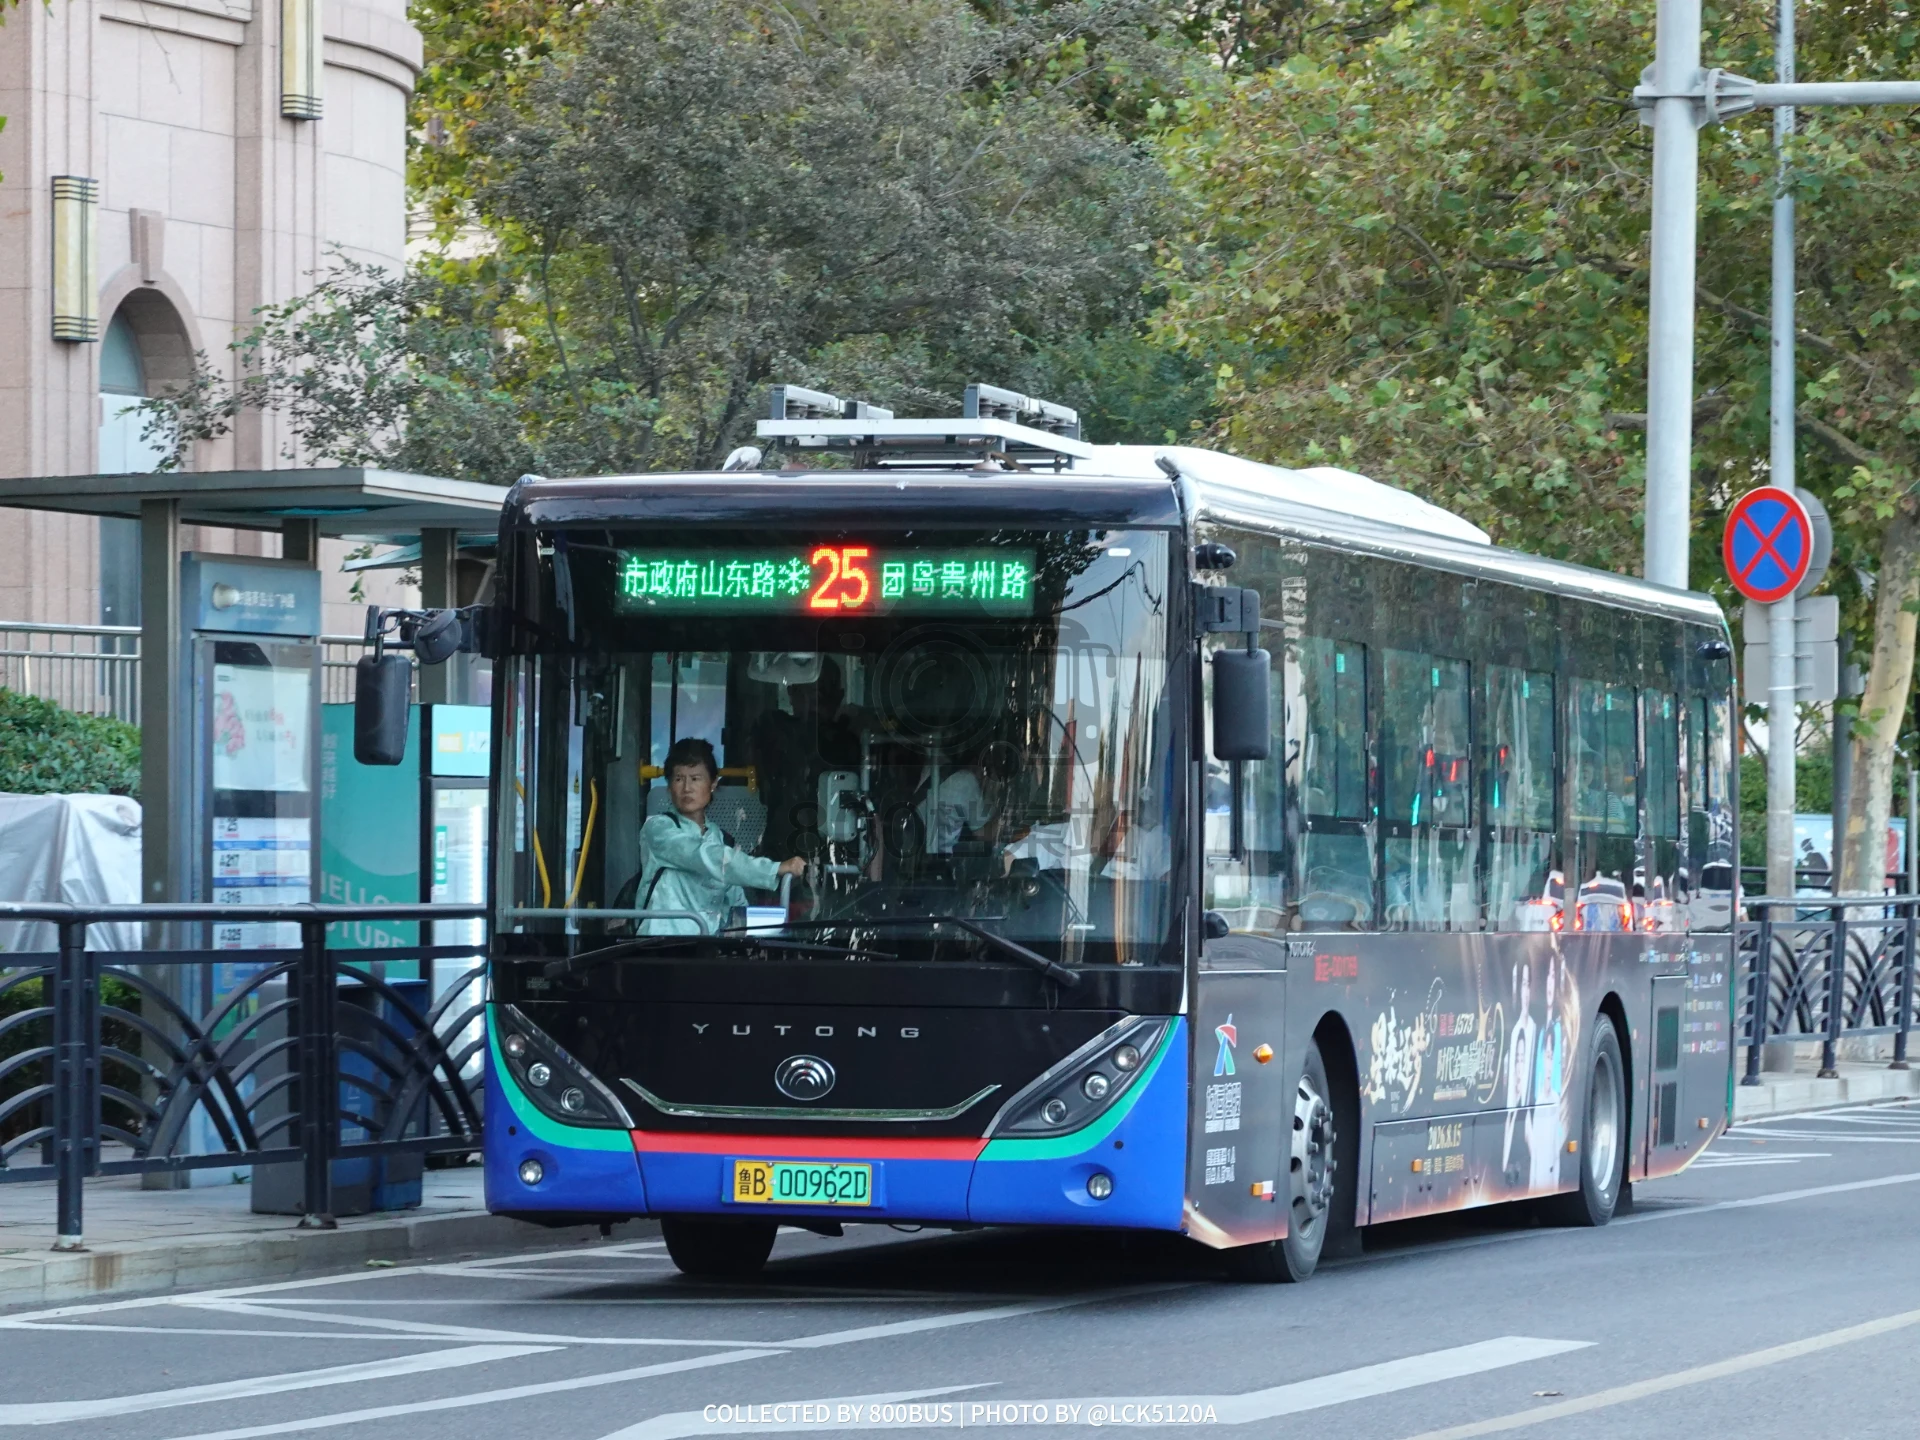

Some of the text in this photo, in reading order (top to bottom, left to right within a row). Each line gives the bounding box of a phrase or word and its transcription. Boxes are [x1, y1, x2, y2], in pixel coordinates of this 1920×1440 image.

[624, 548, 1028, 608] 市政府山东路 25 团岛贵州路
[692, 1022, 920, 1039] YUTONG
[738, 1167, 867, 1199] 鲁B 00962D
